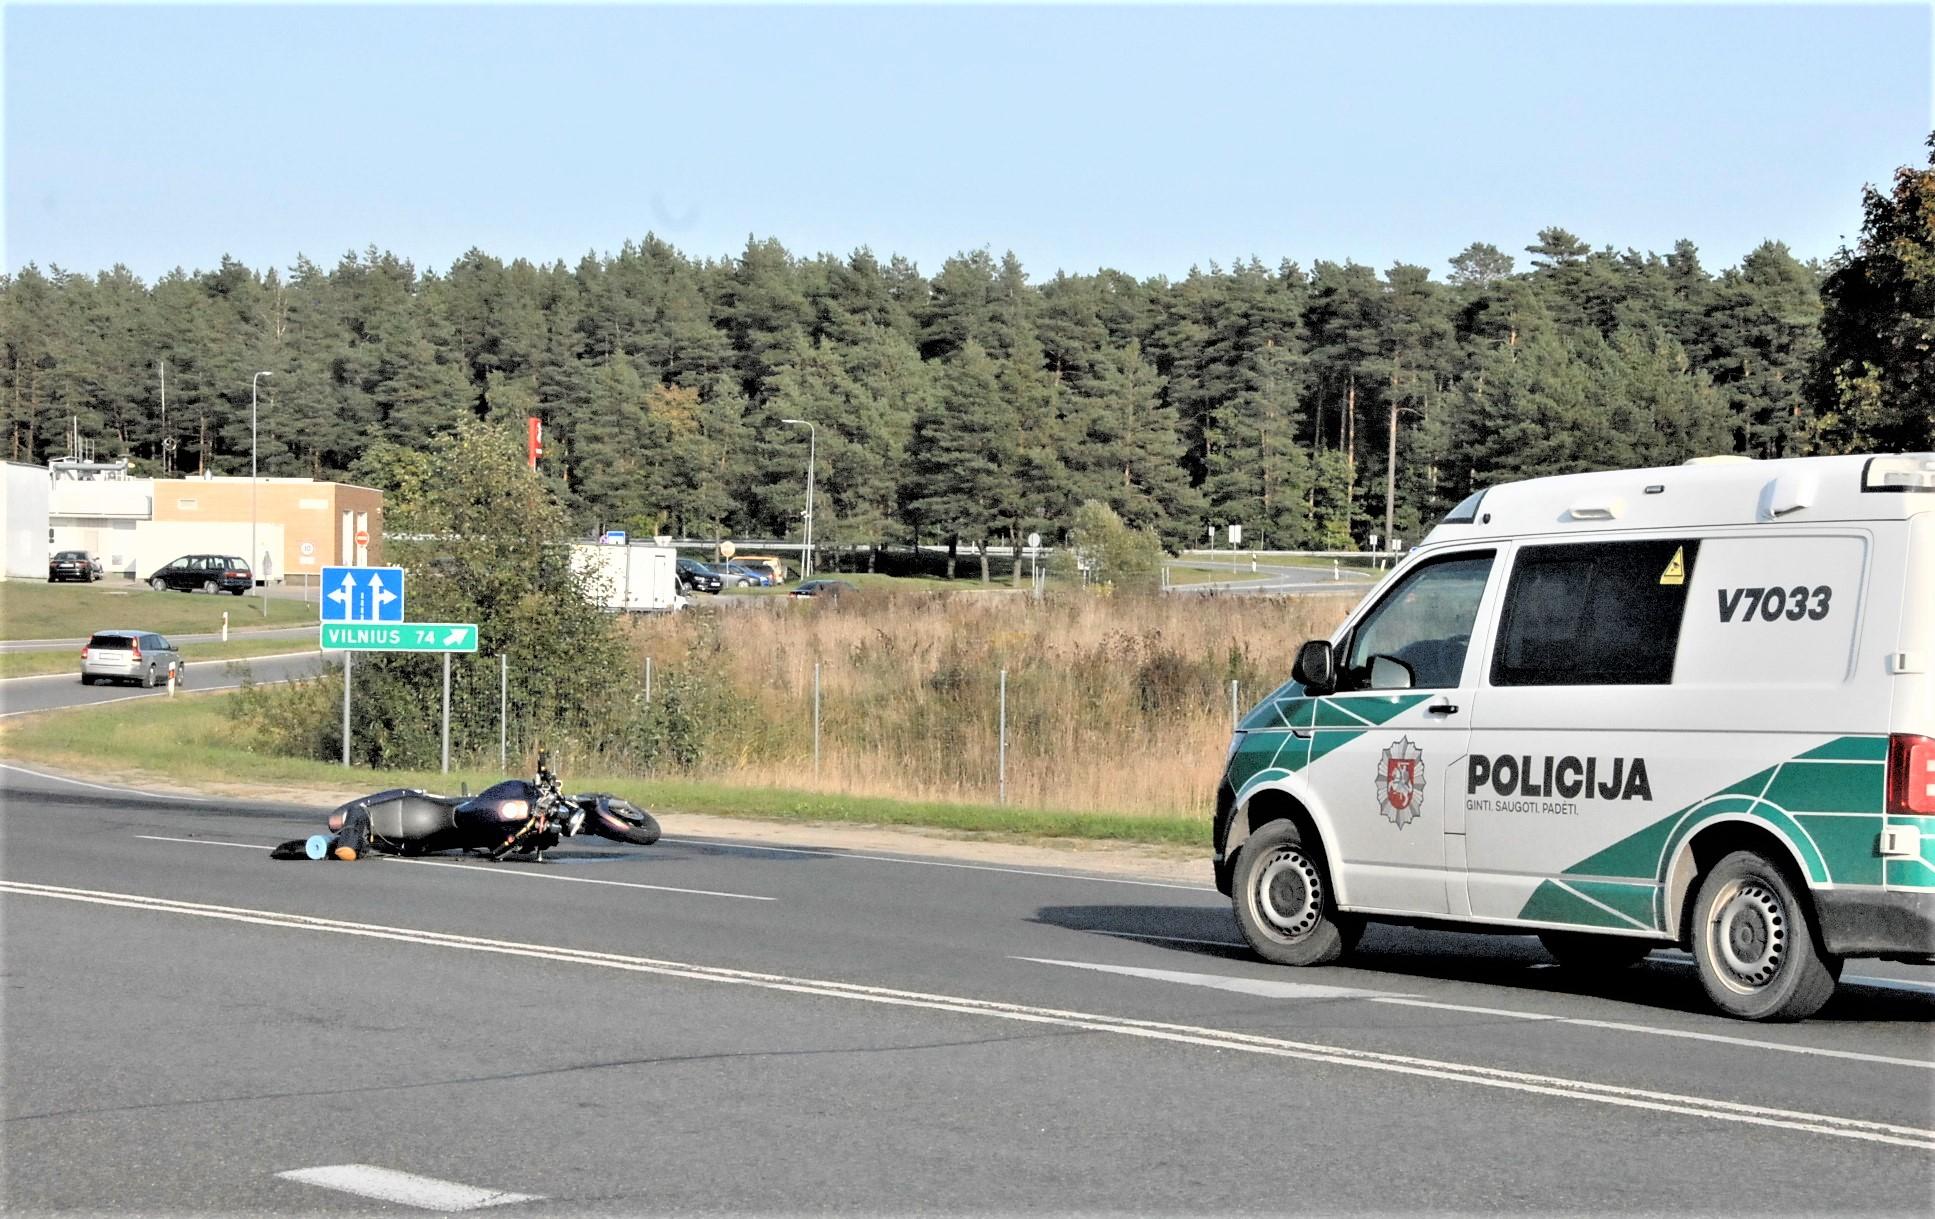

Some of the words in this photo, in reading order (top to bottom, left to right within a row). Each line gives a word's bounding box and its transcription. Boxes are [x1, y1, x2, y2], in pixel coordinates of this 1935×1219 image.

[1718, 585, 1832, 622] V7033
[328, 629, 400, 644] VILNIUS
[415, 630, 435, 645] 74
[1467, 754, 1653, 801] POLICIJA
[1466, 799, 1493, 812] GINTI.
[1495, 801, 1540, 815] SAUGOTI.
[1542, 801, 1579, 816] PADĖTI.
